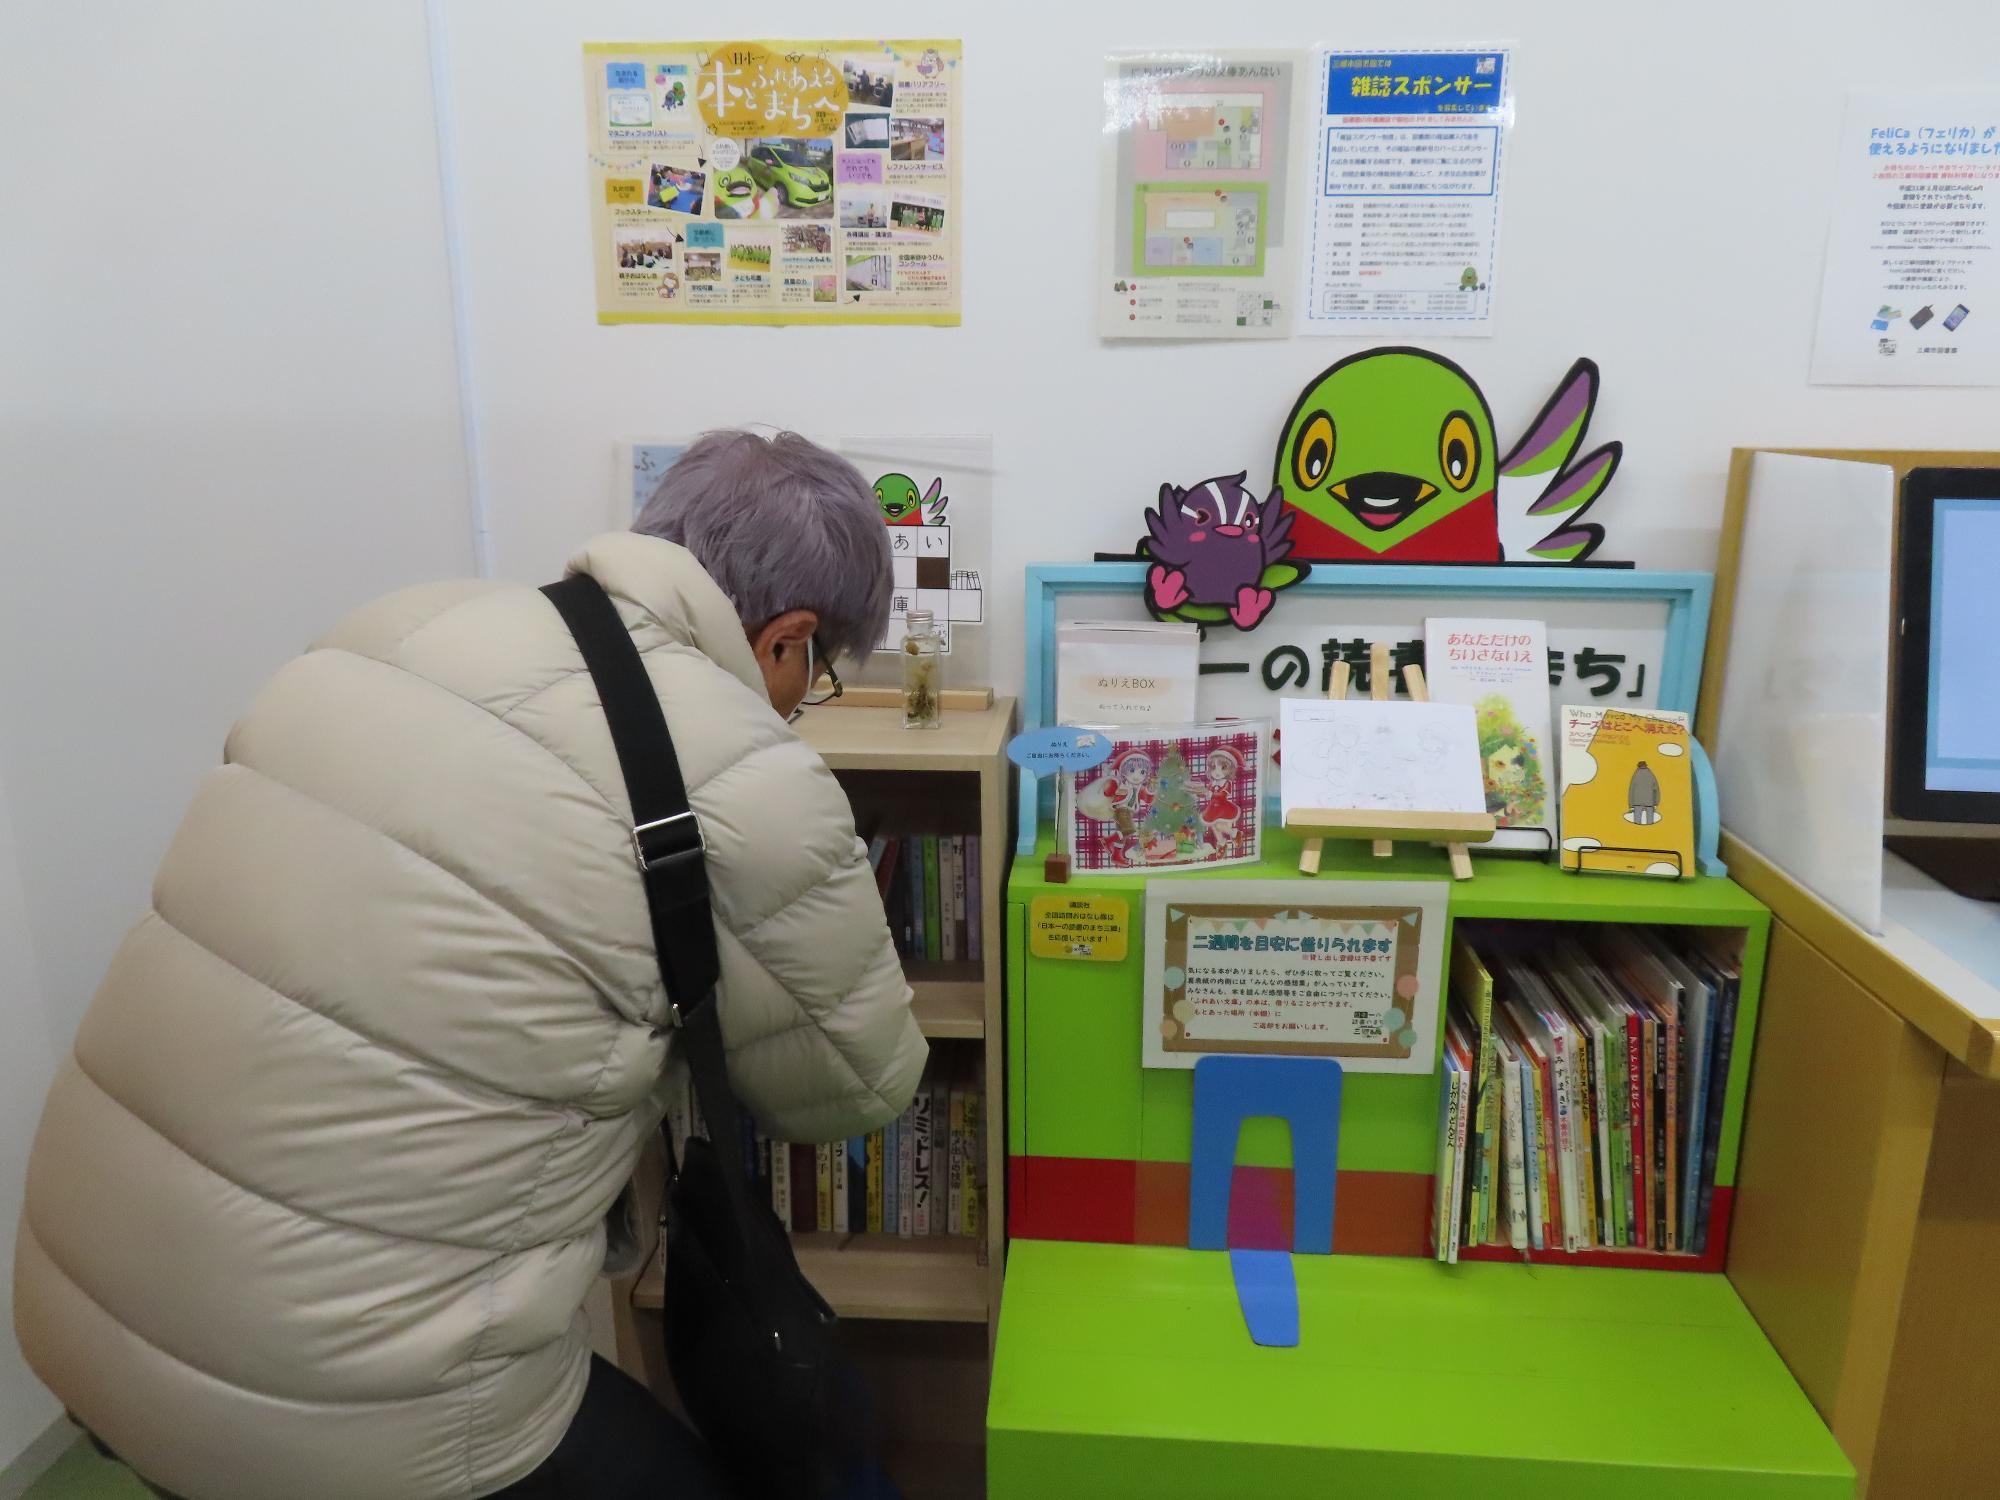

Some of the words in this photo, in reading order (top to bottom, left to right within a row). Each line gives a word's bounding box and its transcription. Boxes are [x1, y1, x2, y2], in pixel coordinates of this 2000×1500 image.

[1352, 75, 1493, 97] 雑誌スポンサー
[893, 533, 910, 551] あ
[925, 535, 943, 549] い
[893, 595, 910, 613] 庫
[1447, 633, 1532, 647] あなただけの
[1448, 647, 1533, 663] ちいさないえ
[1097, 677, 1156, 689] ぬりえBOX
[1192, 933, 1393, 954] 二週間を目安に借りられます
[913, 1096, 931, 1210] リミットレス!
